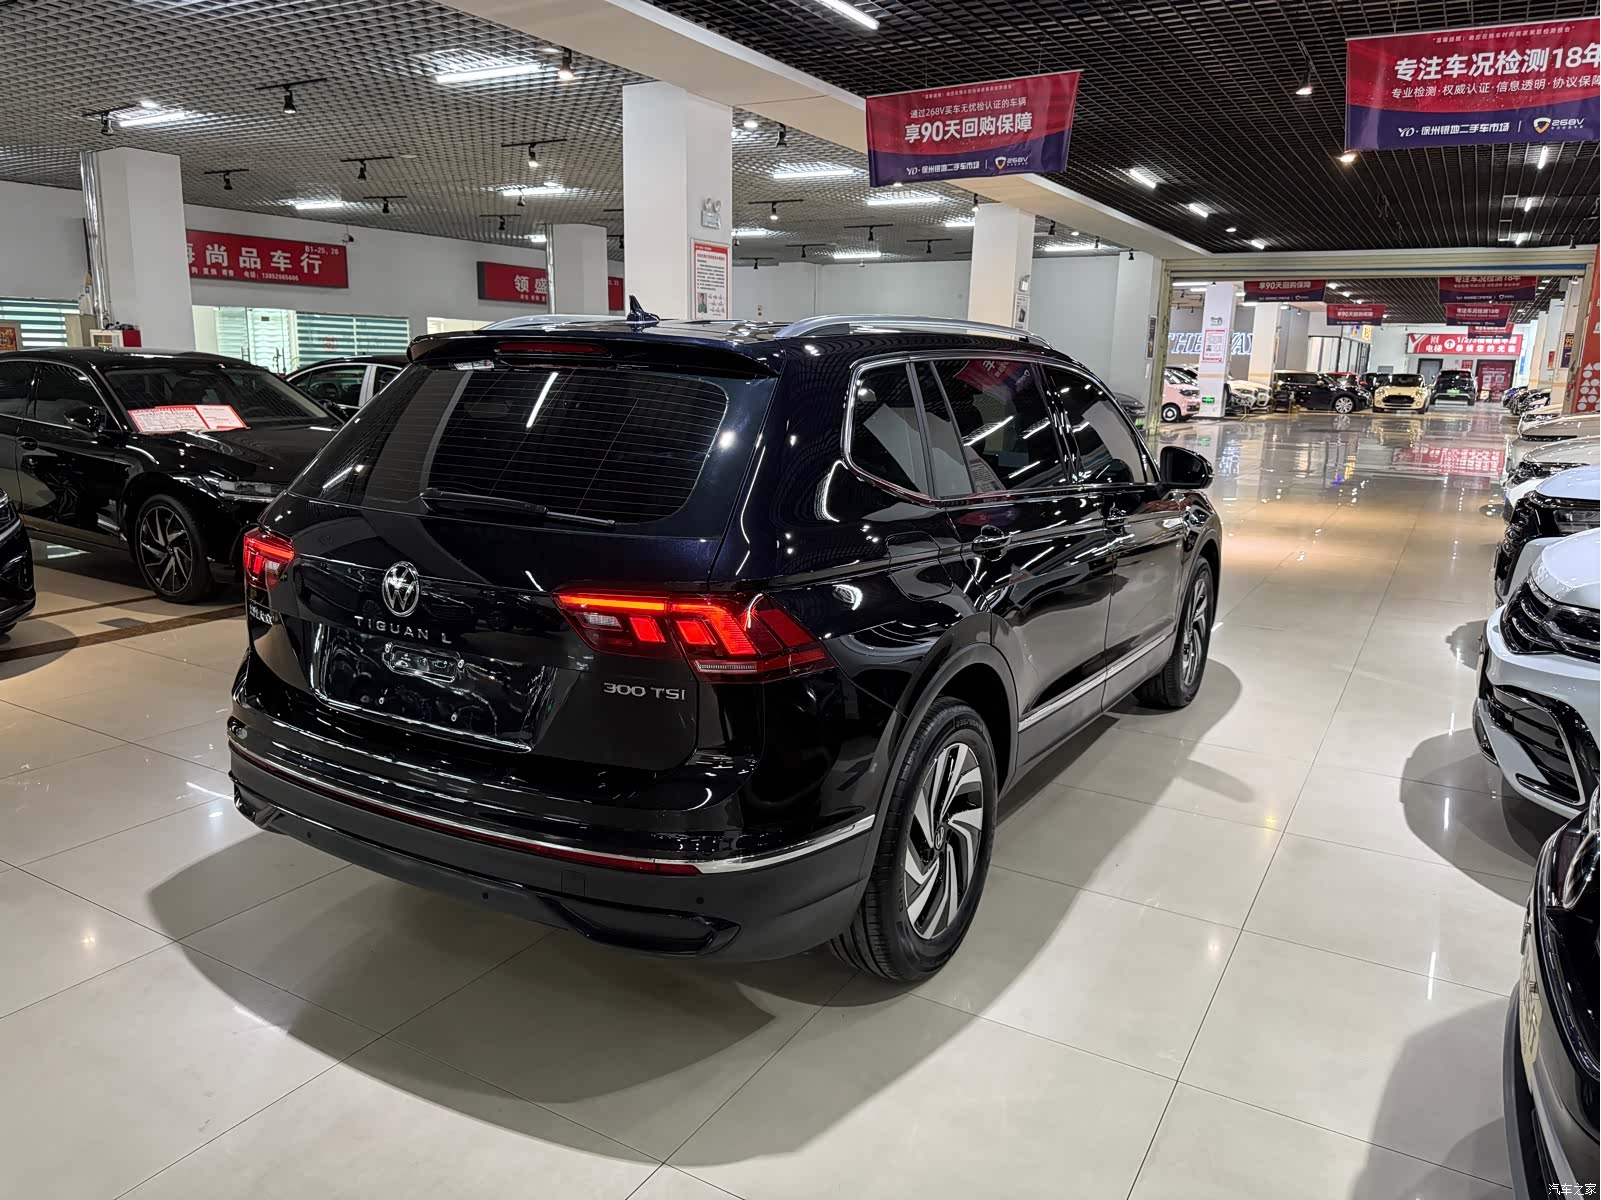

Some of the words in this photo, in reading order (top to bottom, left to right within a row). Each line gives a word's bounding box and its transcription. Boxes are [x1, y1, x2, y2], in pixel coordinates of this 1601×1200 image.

[1394, 42, 1600, 82] 专注车况检测18年
[910, 96, 1027, 119] 通过268V买车无忧检认证的车辆
[904, 111, 1033, 144] 享90天回购保障
[514, 274, 548, 294] 领盛
[354, 615, 429, 641] TIGUAN
[441, 632, 452, 644] L
[603, 682, 646, 697] 300
[650, 687, 685, 700] TSI
